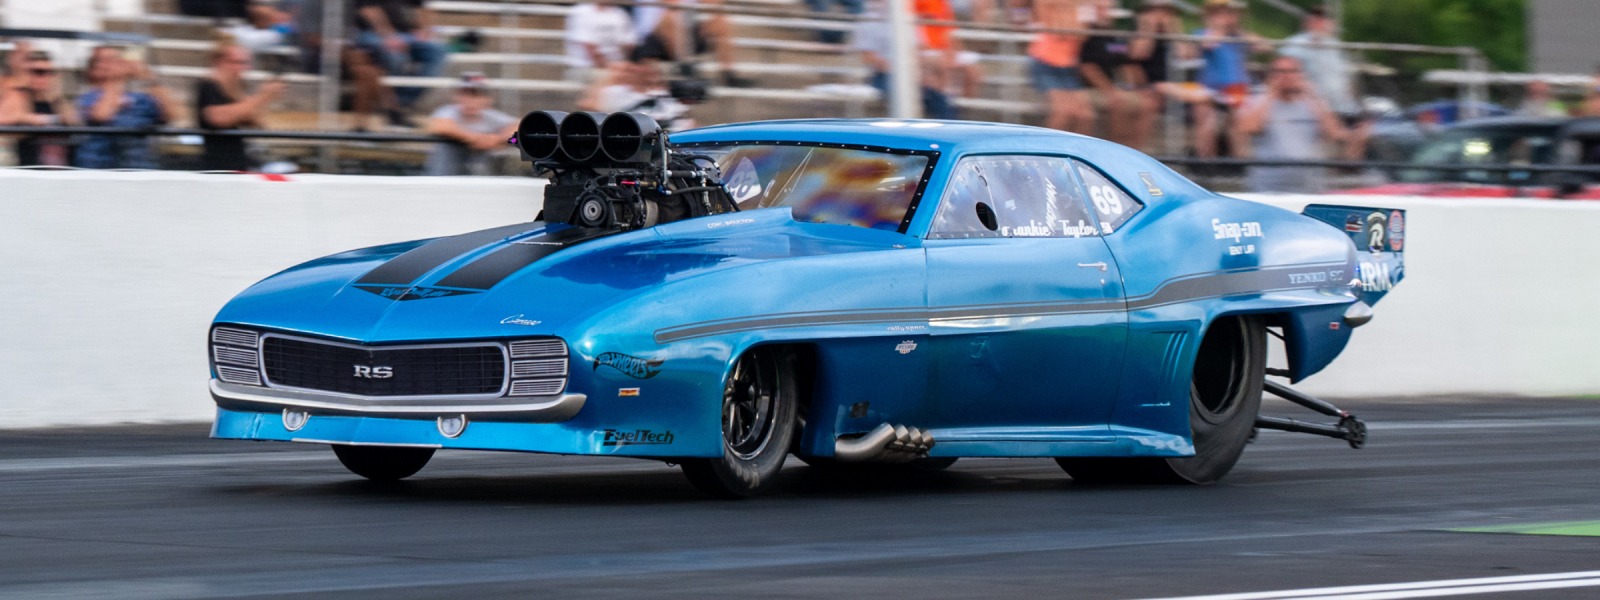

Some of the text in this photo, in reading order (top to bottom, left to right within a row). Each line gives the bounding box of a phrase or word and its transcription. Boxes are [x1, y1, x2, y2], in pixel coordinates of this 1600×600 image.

[1090, 185, 1123, 215] 69
[1058, 219, 1099, 239] Taylor
[1211, 218, 1265, 243] Snap-on
[353, 364, 393, 378] RS
[603, 429, 674, 445] FuelTech
